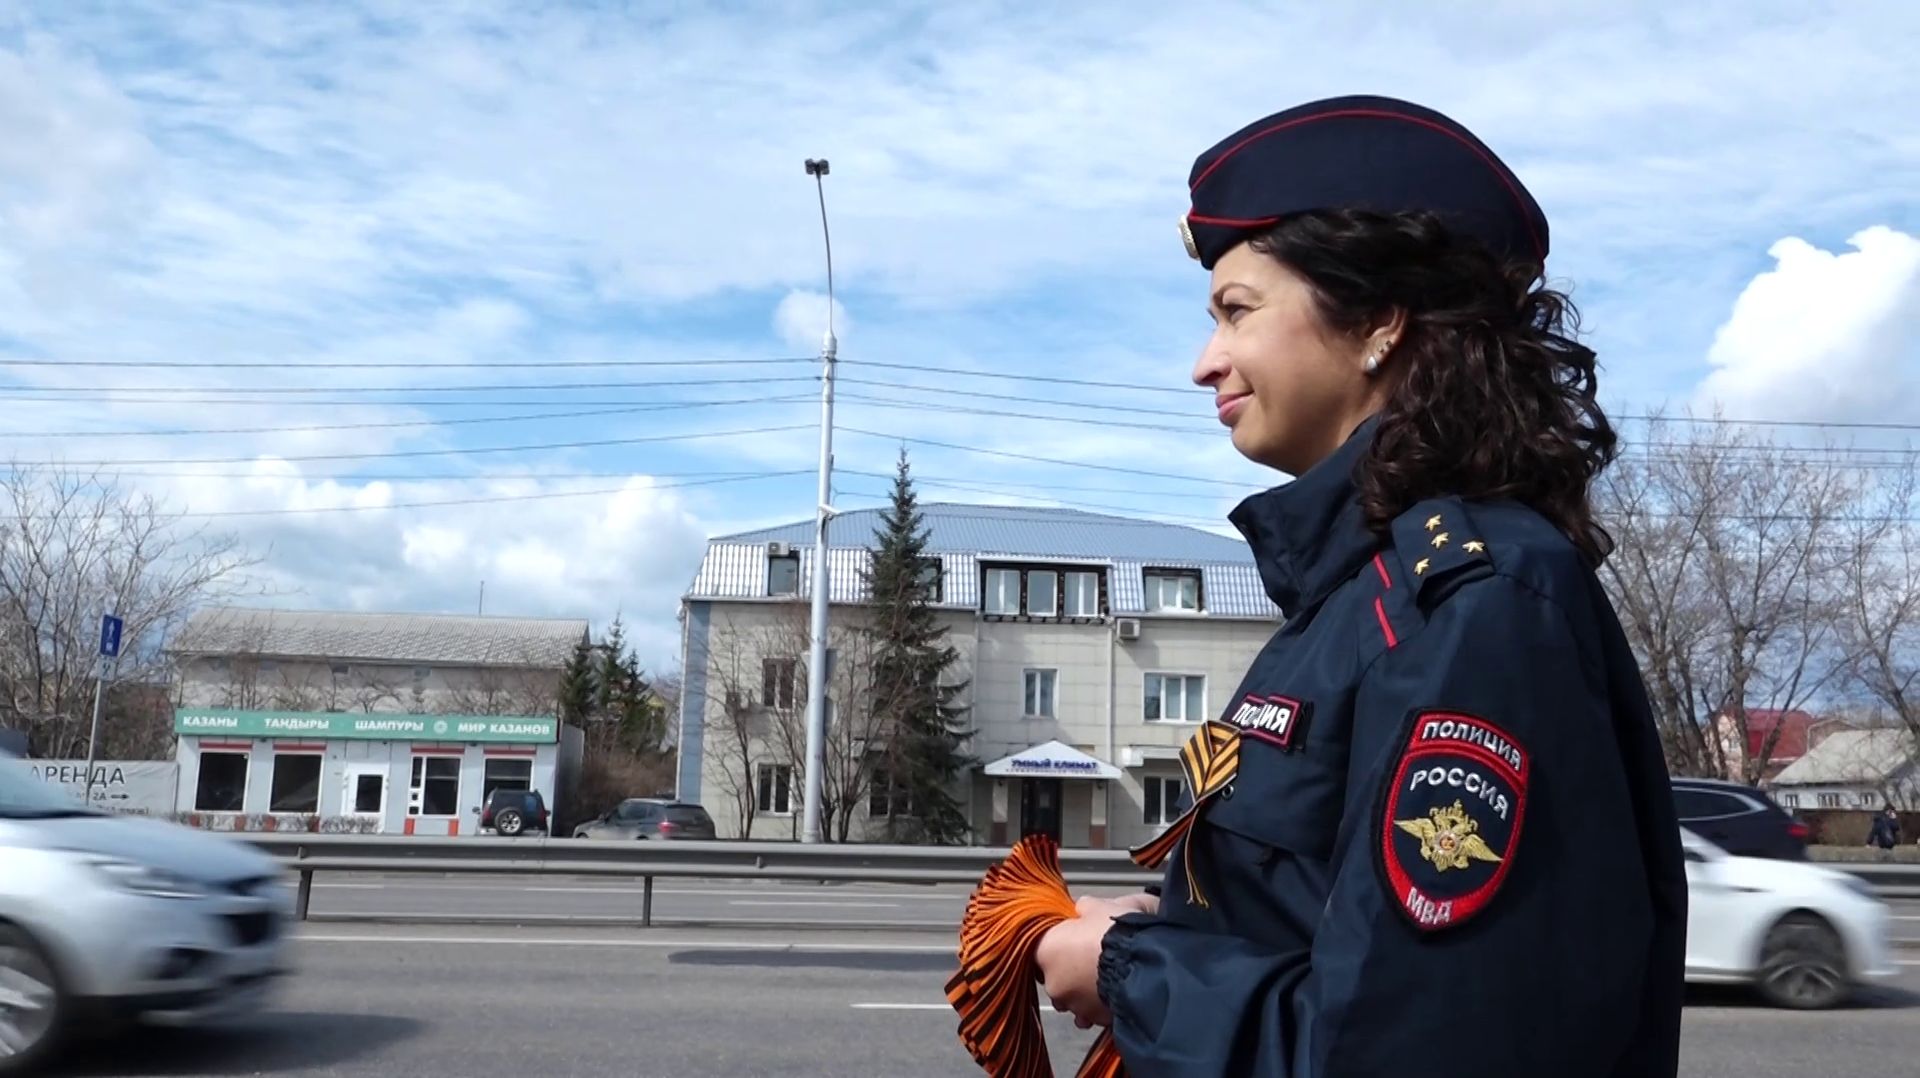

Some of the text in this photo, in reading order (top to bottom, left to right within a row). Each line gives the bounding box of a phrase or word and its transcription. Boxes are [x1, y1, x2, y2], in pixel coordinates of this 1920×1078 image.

[183, 716, 550, 735] КАЗАНЫ ТАНДЫРЫ ШАМПУРЫ МИР КАЗАНОВ
[1232, 702, 1291, 735] ПОЦИЯ
[1422, 720, 1522, 771] ПОЛИЦИЯ
[1011, 758, 1098, 770] УМНЫЙ КЛИМАТ
[1410, 766, 1509, 820] РОССИЯ
[1406, 886, 1453, 924] МВД
